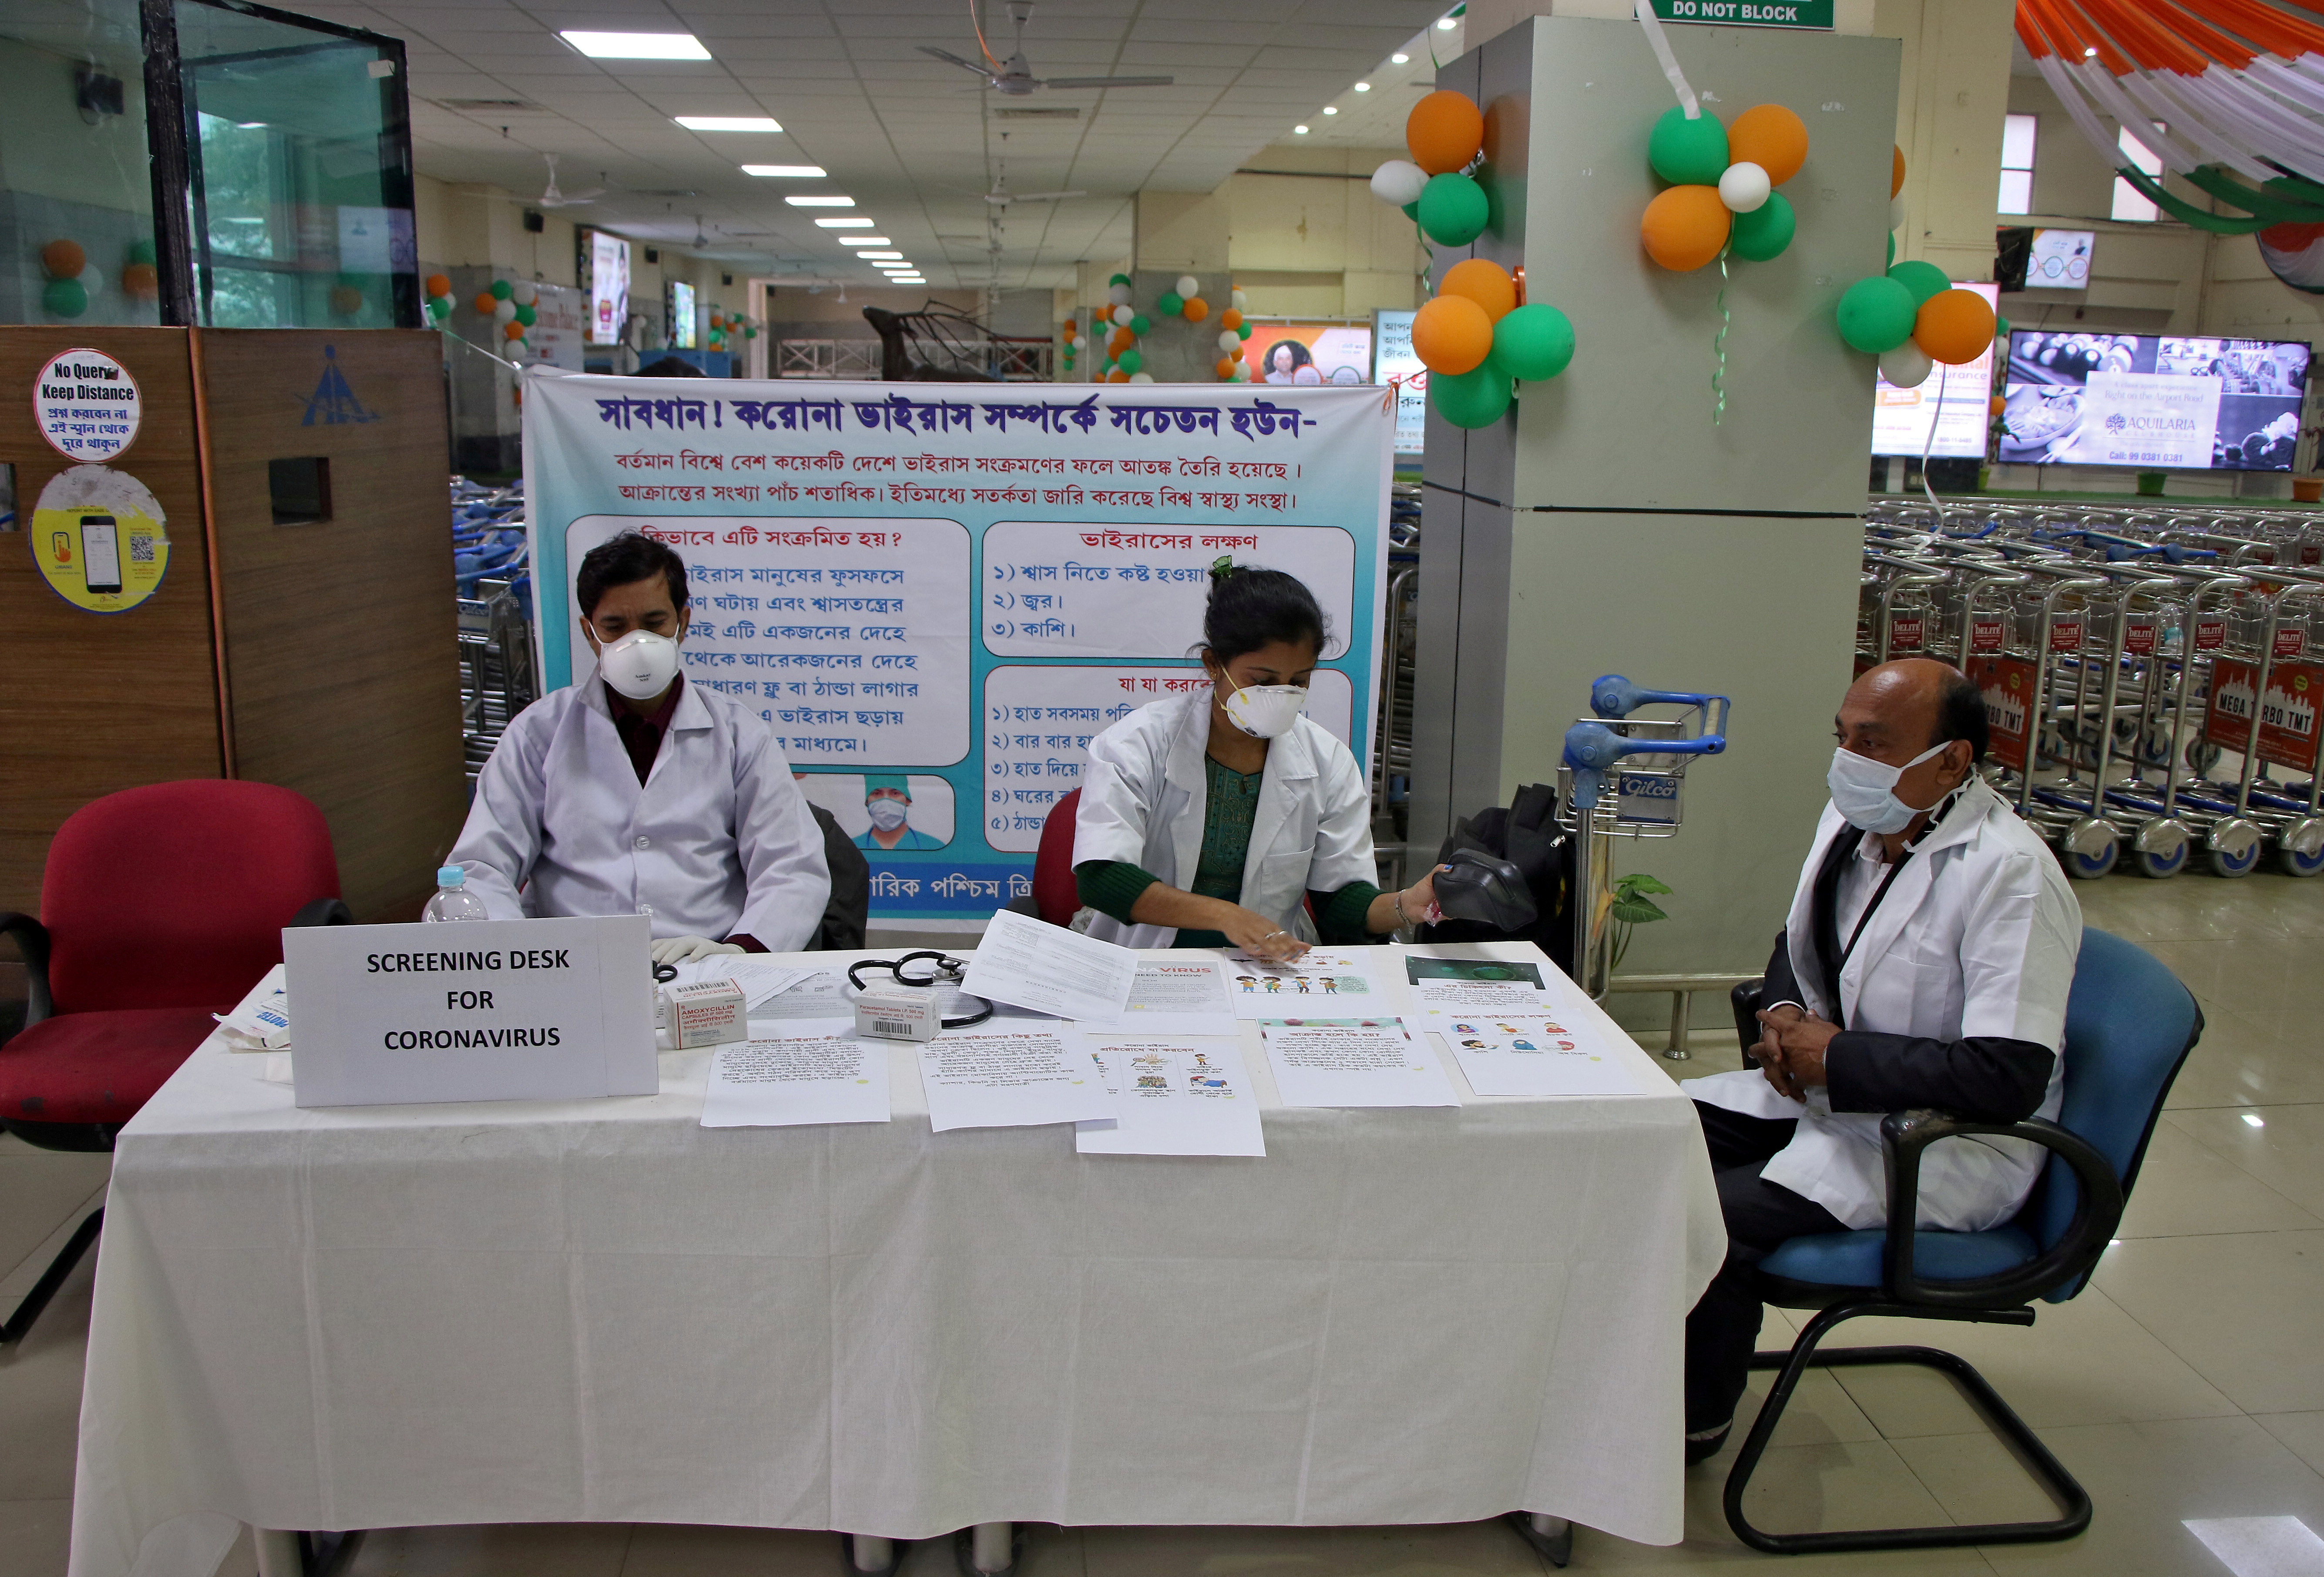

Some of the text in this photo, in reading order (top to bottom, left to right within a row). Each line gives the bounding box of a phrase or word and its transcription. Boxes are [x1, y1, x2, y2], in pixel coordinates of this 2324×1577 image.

[1673, 1, 1797, 21] DO NOT BLOCK
[54, 363, 71, 378] No
[1930, 371, 1988, 380] nsurance
[42, 384, 134, 400] Keep Distance
[2105, 390, 2125, 401] Right
[2139, 391, 2153, 400] the
[2156, 393, 2182, 403] Airport
[2184, 393, 2204, 403] Road
[48, 407, 128, 419] প্রশ্ন করবেন না
[729, 397, 845, 432] করোনা
[850, 393, 975, 436] ভাইরাস
[979, 393, 1100, 434] সম্পর্কে
[1106, 405, 1222, 437] সচেতন
[2128, 416, 2196, 430] AQUILARIA
[48, 420, 67, 433] এই
[99, 423, 129, 434] থেকে
[87, 438, 121, 452] থাকুন
[614, 449, 674, 470] বর্তমান
[679, 449, 723, 471] বিশ্বে
[732, 454, 766, 470] বেশ
[771, 450, 845, 471] কয়েকটি
[853, 455, 896, 471] দেশে
[901, 452, 970, 474] ভাইরাস
[974, 457, 1065, 473] সংক্রমণের
[1071, 460, 1114, 474] ফলে
[1118, 459, 1172, 476] আতঙ্ক
[1178, 456, 1221, 476] তৈরি
[2109, 451, 2126, 460] Call:
[2129, 452, 2139, 460] 99
[618, 484, 705, 502] আক্রান্তের
[711, 485, 760, 501] সংখ্যা
[767, 481, 799, 501] পাঁচ
[888, 482, 965, 504] ইতিমধ্যে
[971, 483, 1037, 504] সতর্কতা
[1042, 484, 1084, 505] জারি
[1090, 491, 1154, 508] করেছে
[1159, 486, 1192, 508] বিশ্ব
[1197, 491, 1239, 511] স্বাস্থ্য
[722, 526, 759, 546] এটি
[764, 526, 852, 547] সংক্রমিত
[1079, 528, 1259, 550] ভাইরাসের লক্ষণ
[685, 564, 743, 585] াইরাস
[749, 568, 822, 587] মানুষের
[1020, 565, 1058, 581] শ্বাস
[1063, 561, 1111, 581] নিতে
[1115, 563, 1150, 581] কষ্ট
[1155, 567, 1205, 584] হওয়া
[712, 593, 759, 611] ঘটায়
[767, 598, 806, 611] এবং
[810, 597, 904, 614] শ্বাসতন্ত্রের
[722, 621, 756, 639] এটি
[763, 626, 851, 640] একজনের
[860, 627, 907, 642] দেহে
[2199, 627, 2222, 635] DELITE
[682, 651, 918, 670] থেকে আরেকজনের দেহে
[762, 677, 919, 699] ফ্লু বা ঠান্ডা লাগার
[1118, 677, 1158, 692] যা যা
[777, 706, 849, 725] ভাইরাস
[854, 710, 904, 727] ছড়ায়
[1013, 706, 1043, 722] হাত
[1046, 708, 1100, 721] সবসময়
[2005, 710, 2022, 731] TMT
[2220, 693, 2311, 732] MEGA TMT
[1013, 734, 1040, 748] বার
[1044, 734, 1071, 749] বার
[1013, 762, 1042, 778] হাত
[1046, 758, 1078, 777] দিয়ে
[1013, 791, 1054, 803] ঘরের
[1625, 779, 1676, 798] Gilco
[930, 872, 1000, 898] পশ্চিম
[367, 949, 570, 973] SCREENING DESK
[447, 990, 494, 1010] FOR
[682, 1004, 735, 1016] AMOXYCILLIN
[384, 1027, 561, 1050] CORONAVIRUS
